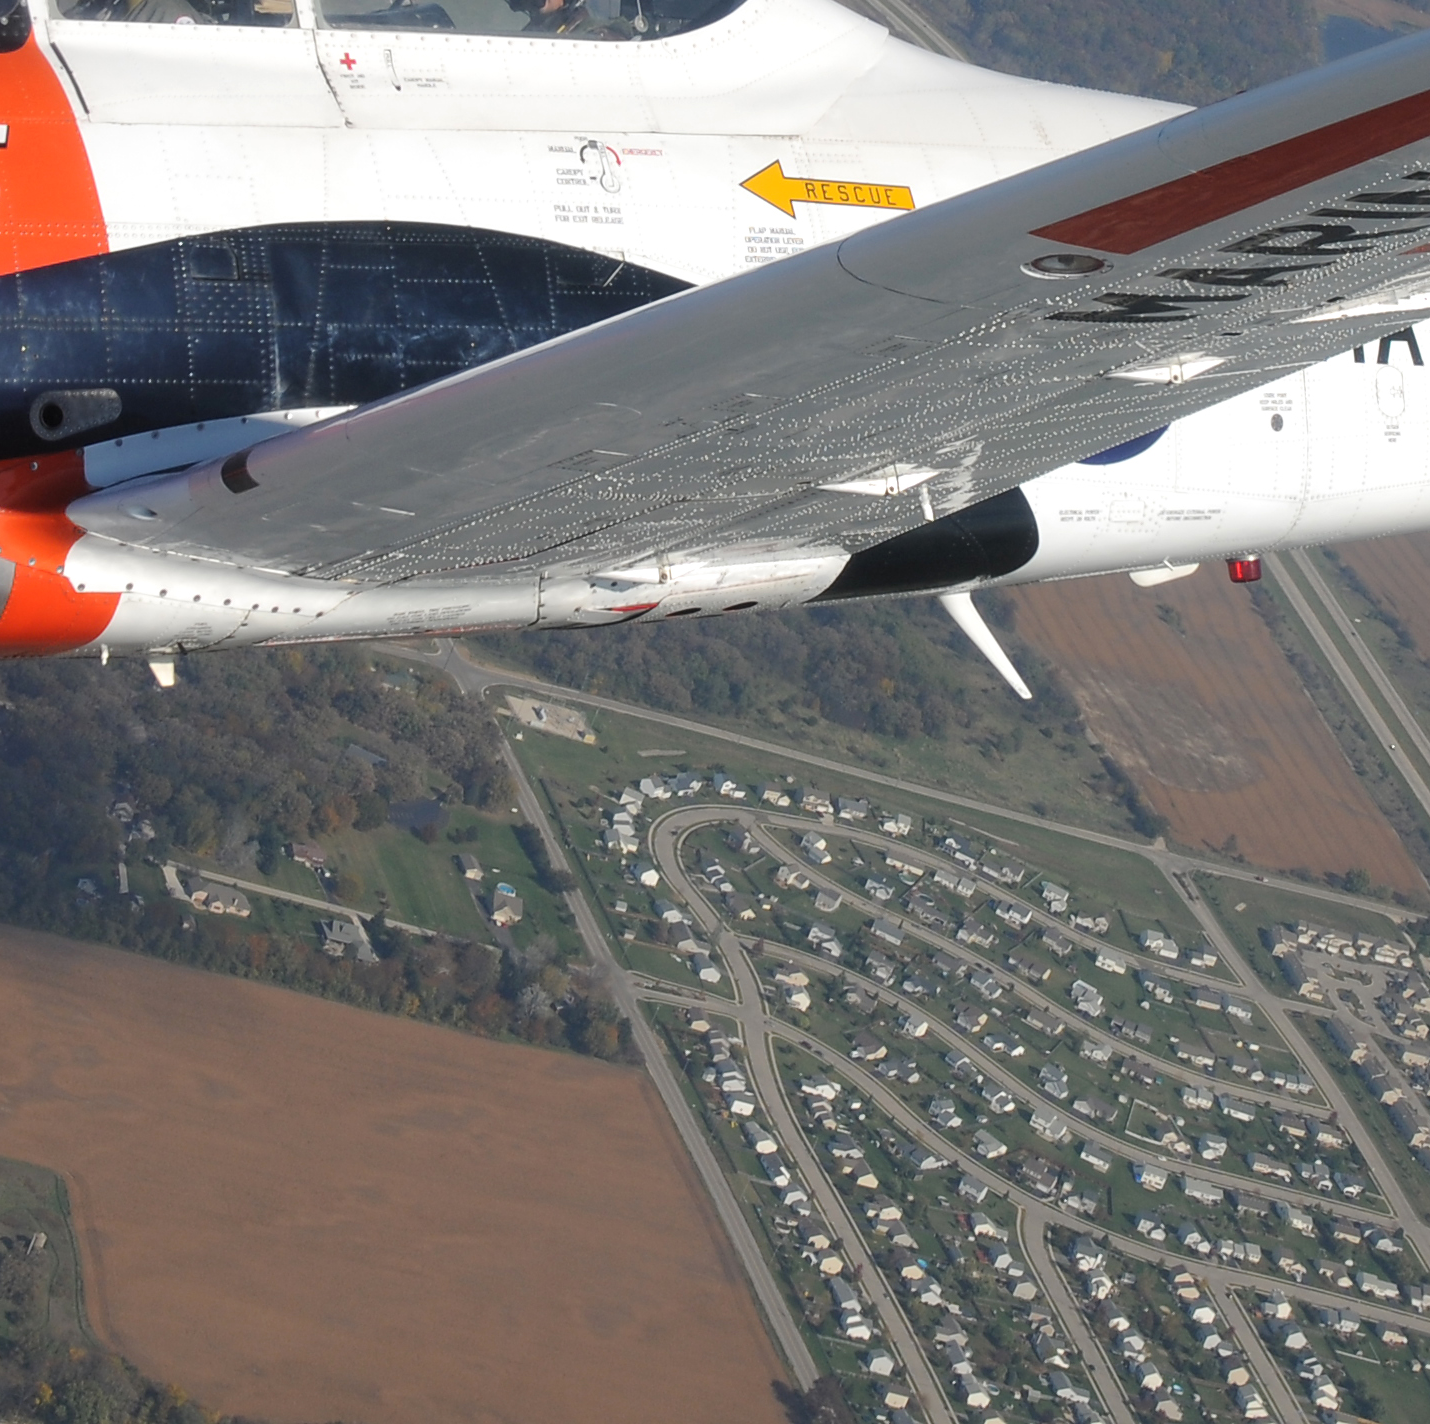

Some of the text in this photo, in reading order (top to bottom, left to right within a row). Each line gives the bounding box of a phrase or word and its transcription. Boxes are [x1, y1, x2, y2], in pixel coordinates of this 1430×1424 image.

[804, 182, 897, 206] RESCUE
[553, 204, 573, 213] PULL
[576, 205, 589, 213] OUT
[554, 214, 569, 222] FOR
